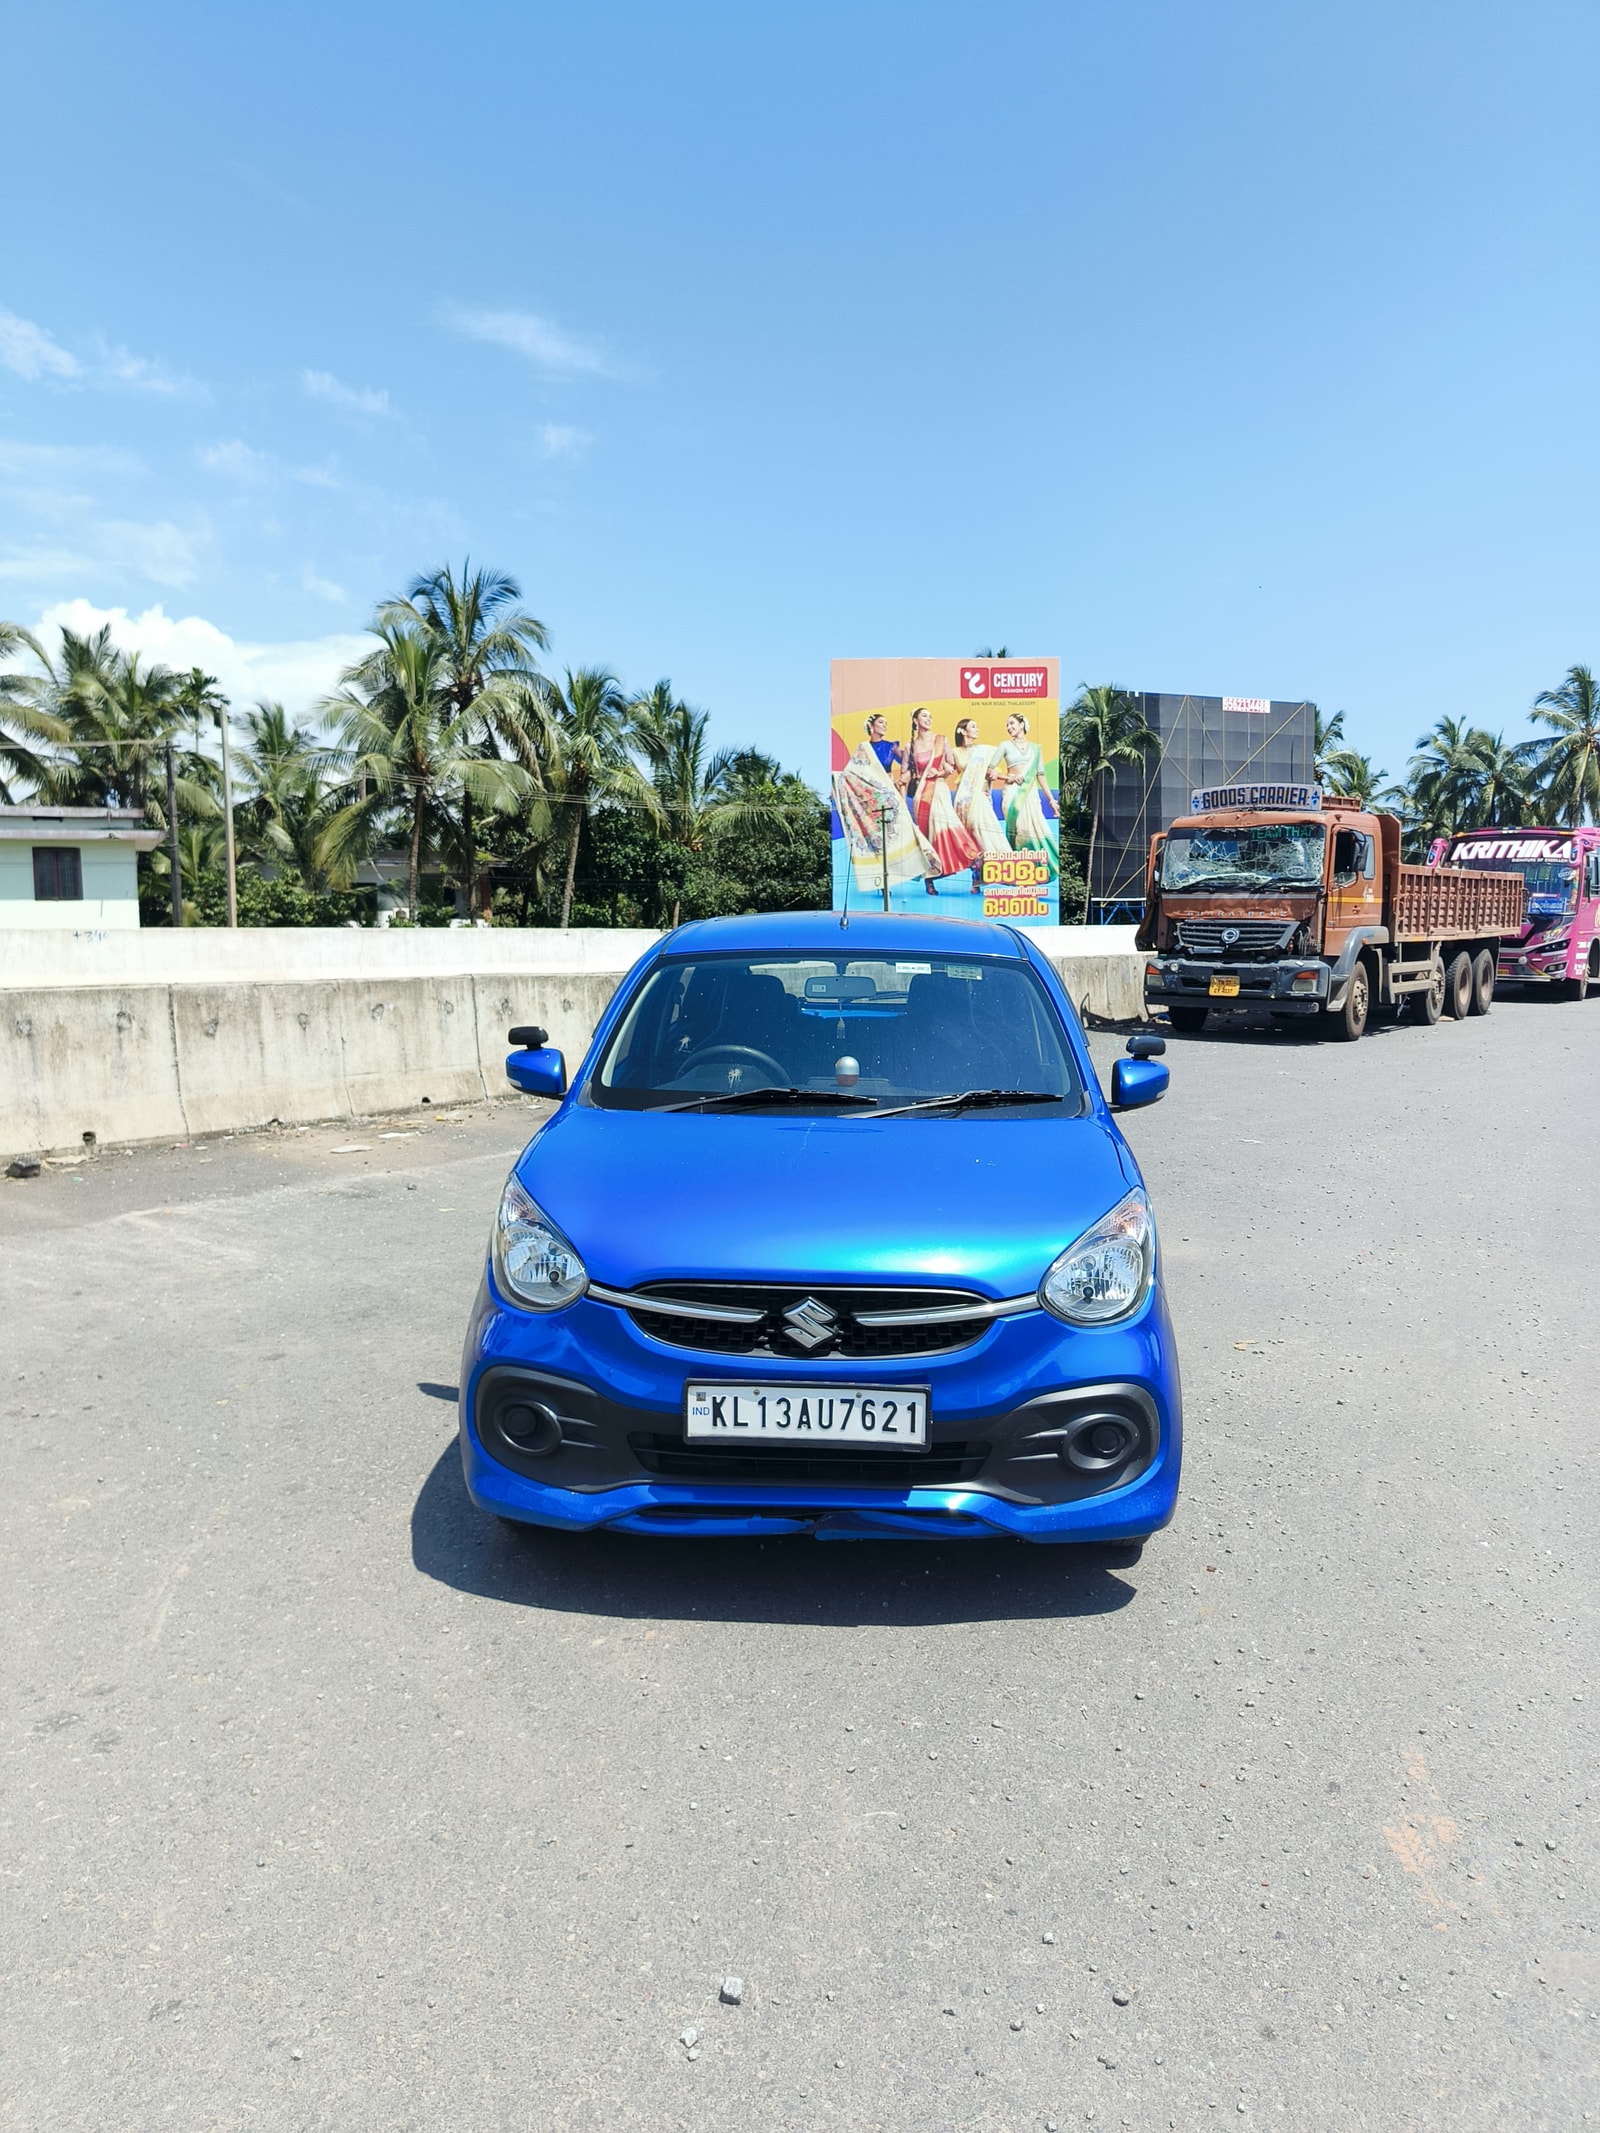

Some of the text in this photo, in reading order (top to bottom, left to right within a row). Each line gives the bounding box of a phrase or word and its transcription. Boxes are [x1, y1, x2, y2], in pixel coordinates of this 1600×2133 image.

[993, 672, 1044, 688] CENTURY
[1202, 786, 1308, 810] GOODS CARRIER
[1451, 840, 1572, 861] KRITHIKA
[983, 897, 1048, 916] ഓണം
[692, 1407, 710, 1416] IND
[711, 1395, 917, 1434] KL13AU7621
